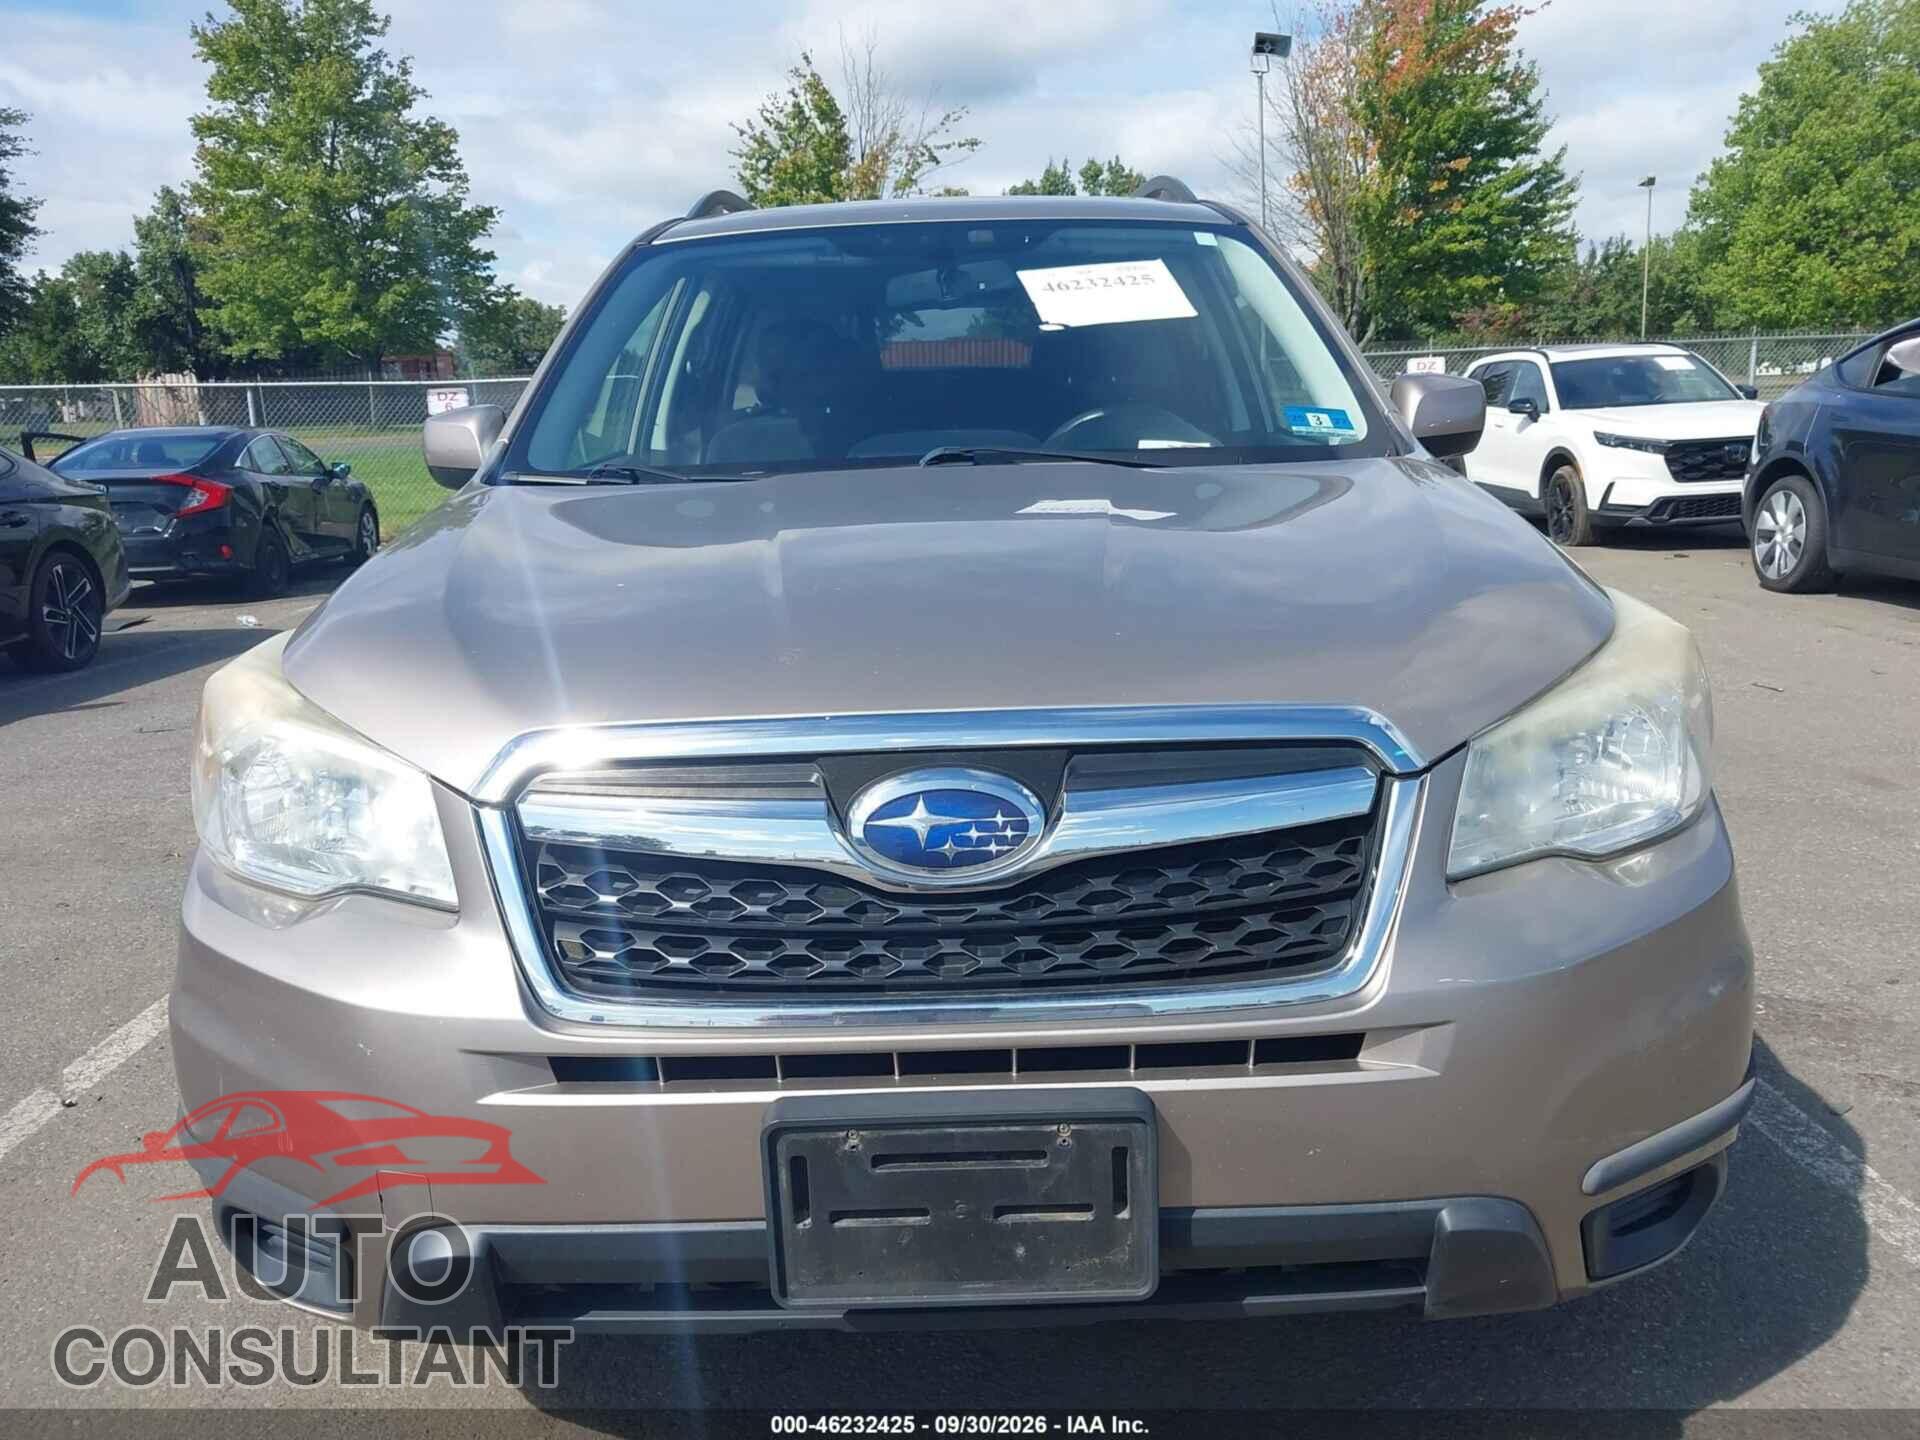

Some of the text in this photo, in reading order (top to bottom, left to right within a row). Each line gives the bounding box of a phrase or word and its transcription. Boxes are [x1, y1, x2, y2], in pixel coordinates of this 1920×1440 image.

[1041, 273, 1156, 293] 46232425
[1416, 361, 1437, 371] DZ
[436, 392, 458, 402] DZ
[1312, 414, 1323, 426] 3
